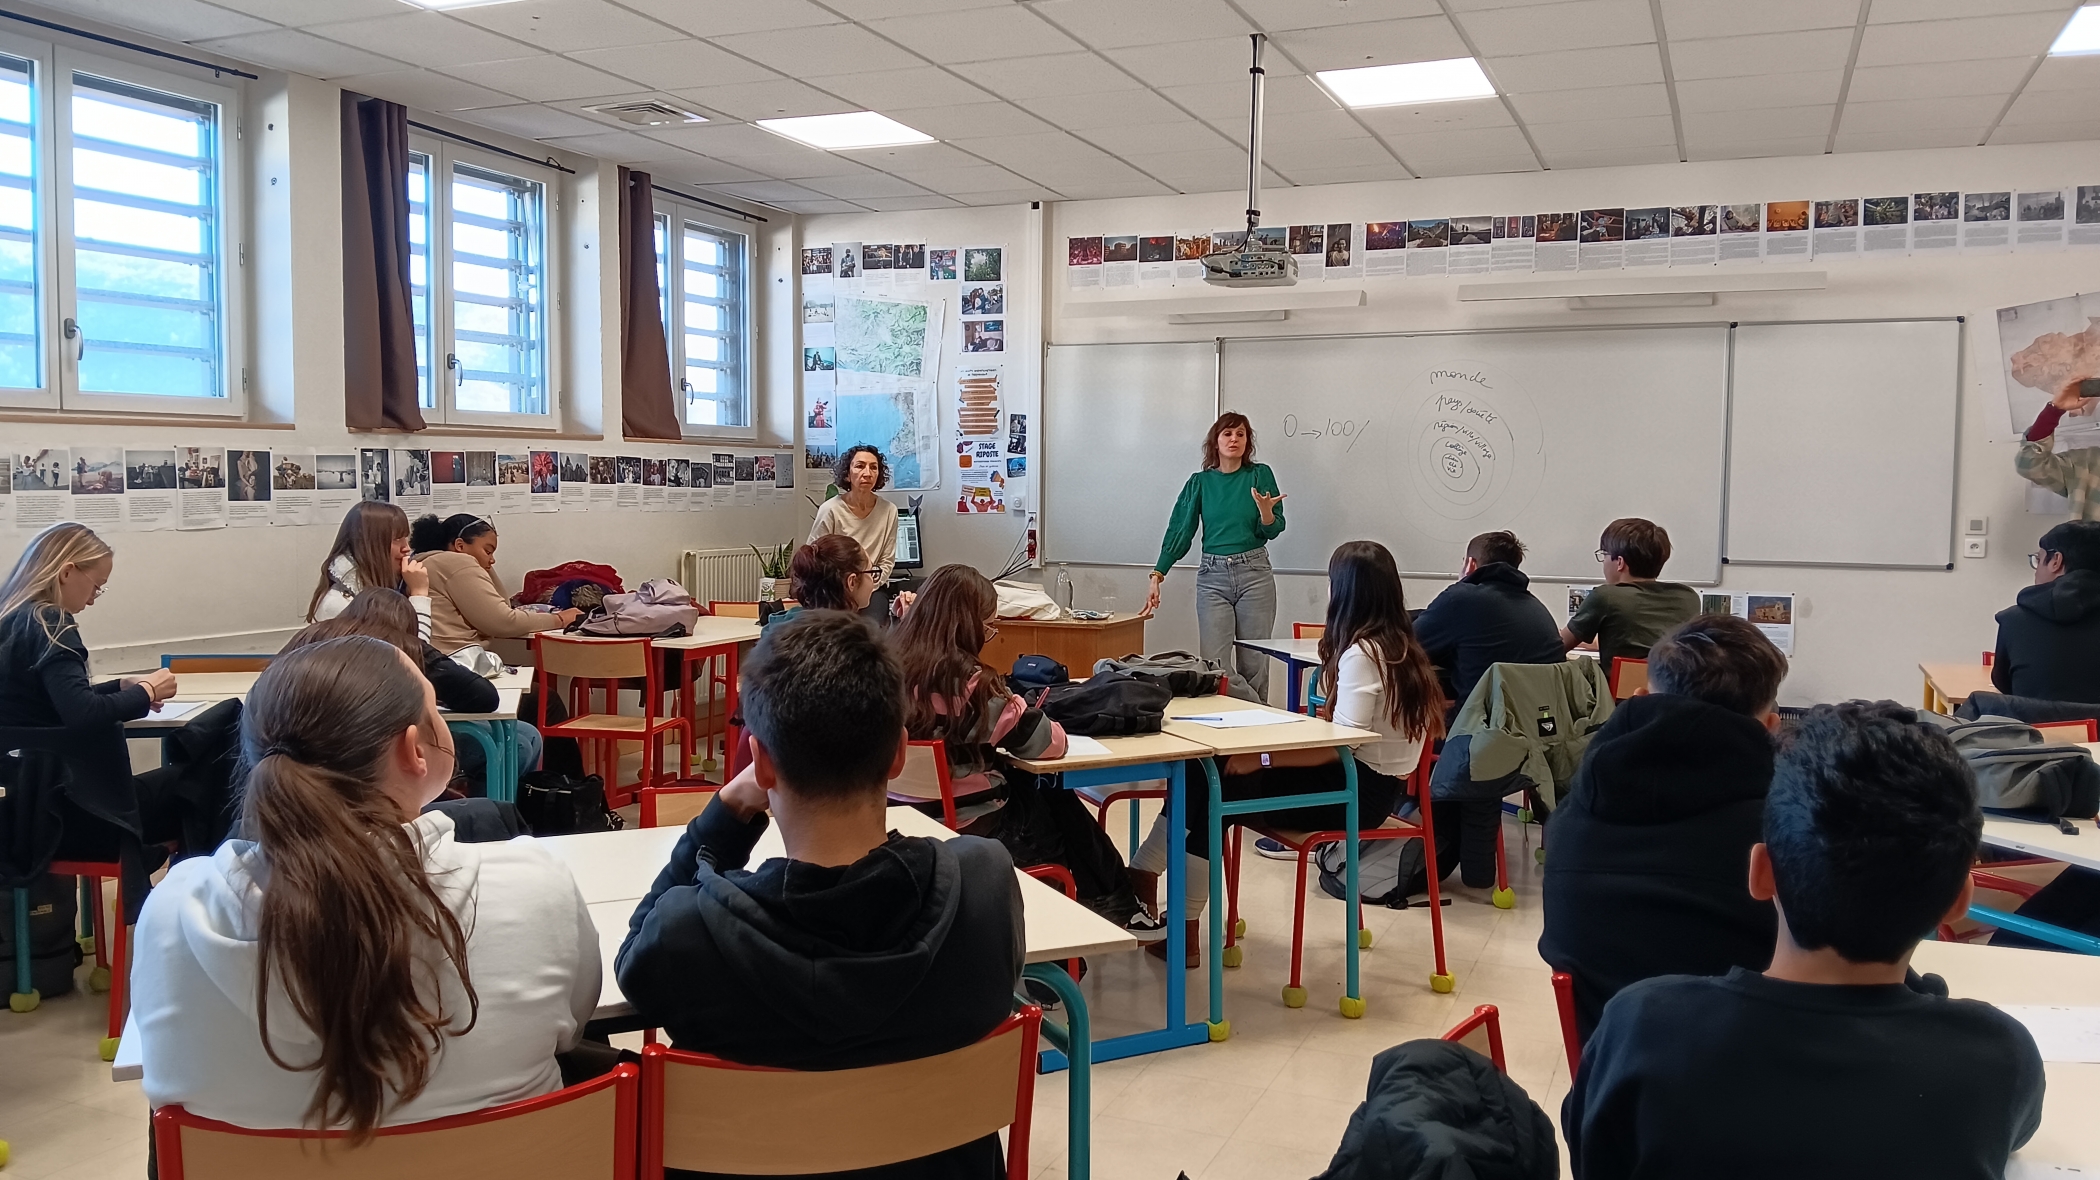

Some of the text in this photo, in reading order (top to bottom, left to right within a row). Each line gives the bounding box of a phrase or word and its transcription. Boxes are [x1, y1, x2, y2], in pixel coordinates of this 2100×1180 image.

[1430, 370, 1493, 389] monde
[978, 442, 996, 450] STAGE
[975, 450, 999, 458] RIPOSTE
